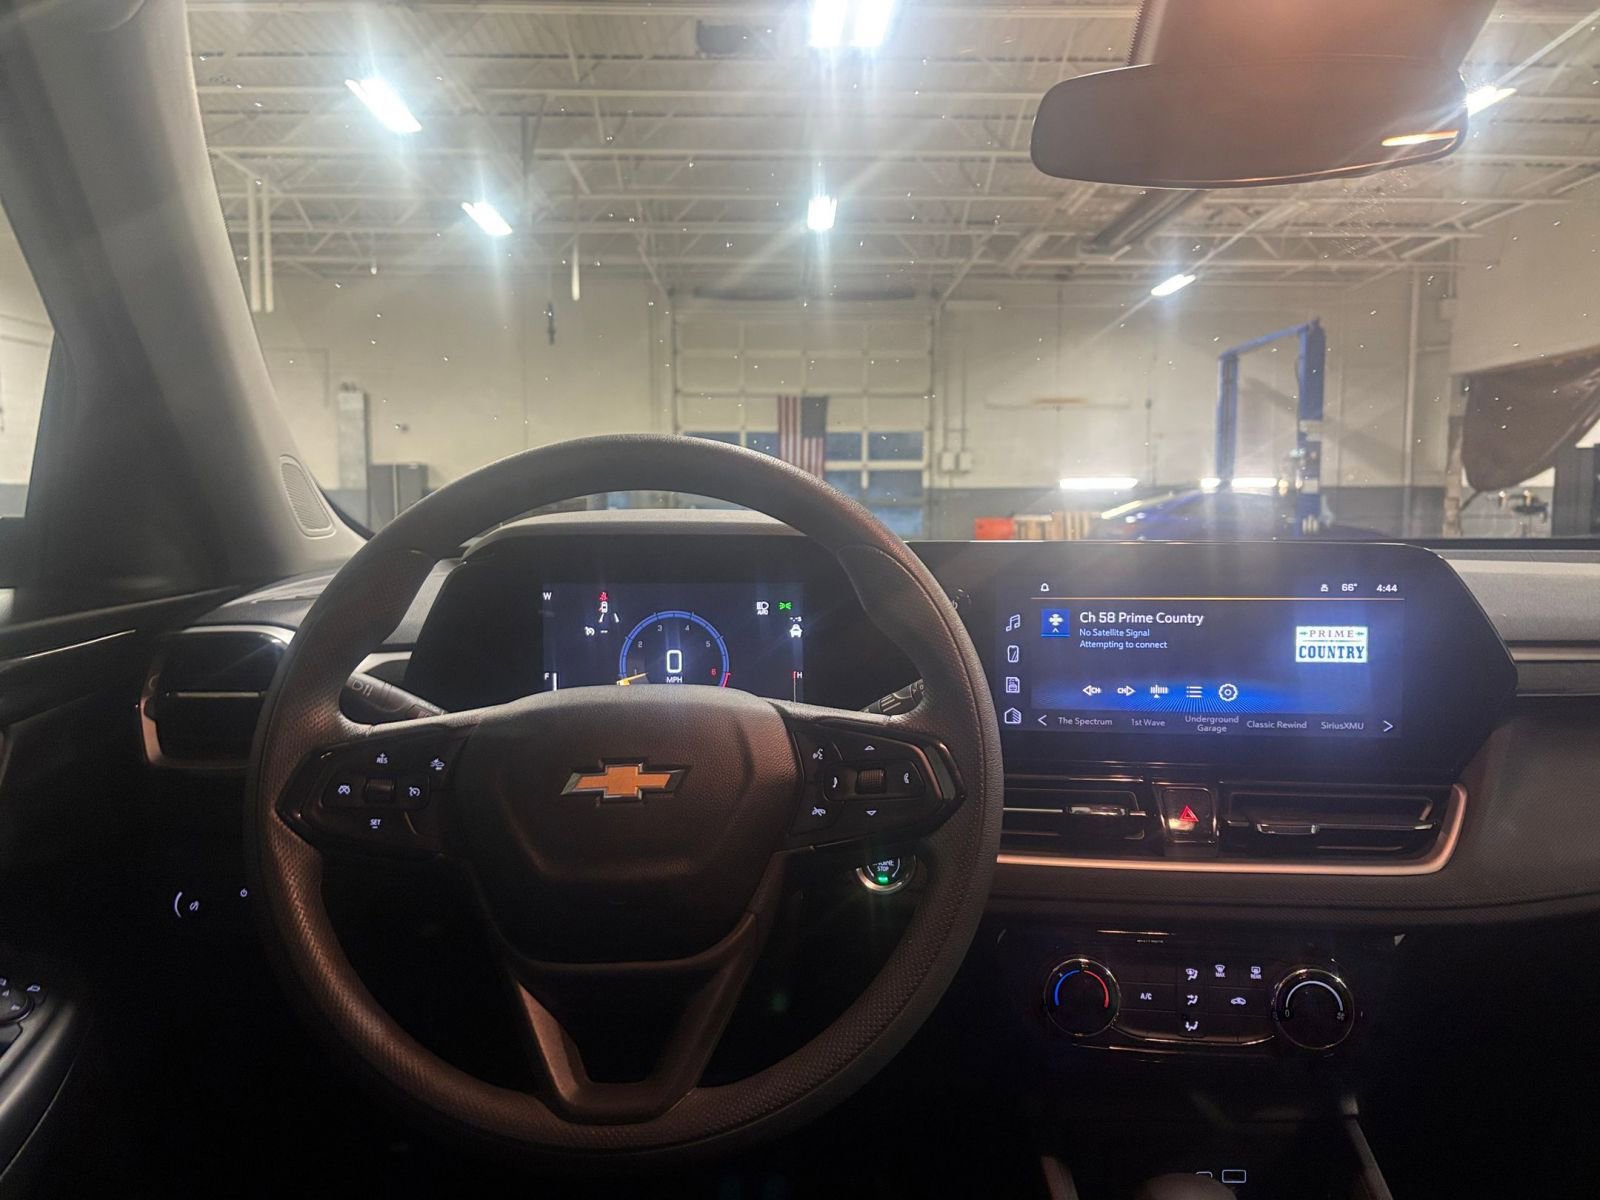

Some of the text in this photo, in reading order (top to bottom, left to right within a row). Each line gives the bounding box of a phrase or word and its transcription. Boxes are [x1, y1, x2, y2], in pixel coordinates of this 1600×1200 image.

[1376, 583, 1398, 593] 4:44
[542, 591, 552, 600] W
[1079, 611, 1205, 627] Ch 58 Prime Country
[657, 624, 663, 632] 3
[684, 624, 690, 632] 4
[1079, 628, 1150, 639] No Satellite Signal
[1309, 629, 1355, 639] PRIME
[637, 640, 643, 648] 2
[705, 640, 711, 648] 5
[1079, 640, 1168, 650] Attempting to connect
[1298, 644, 1365, 660] COUNTRY
[544, 672, 550, 680] F
[796, 671, 803, 679] H
[666, 676, 683, 684] MPH
[1058, 716, 1113, 727] The Spectrum
[1131, 718, 1166, 727] 1st Wave
[1185, 714, 1240, 725] Underground
[1197, 724, 1228, 734] Garage
[1246, 720, 1308, 730] Classic Rewind
[1320, 721, 1365, 730] SiriusXMU
[370, 818, 381, 826] SET
[1140, 992, 1153, 1000] A/C
